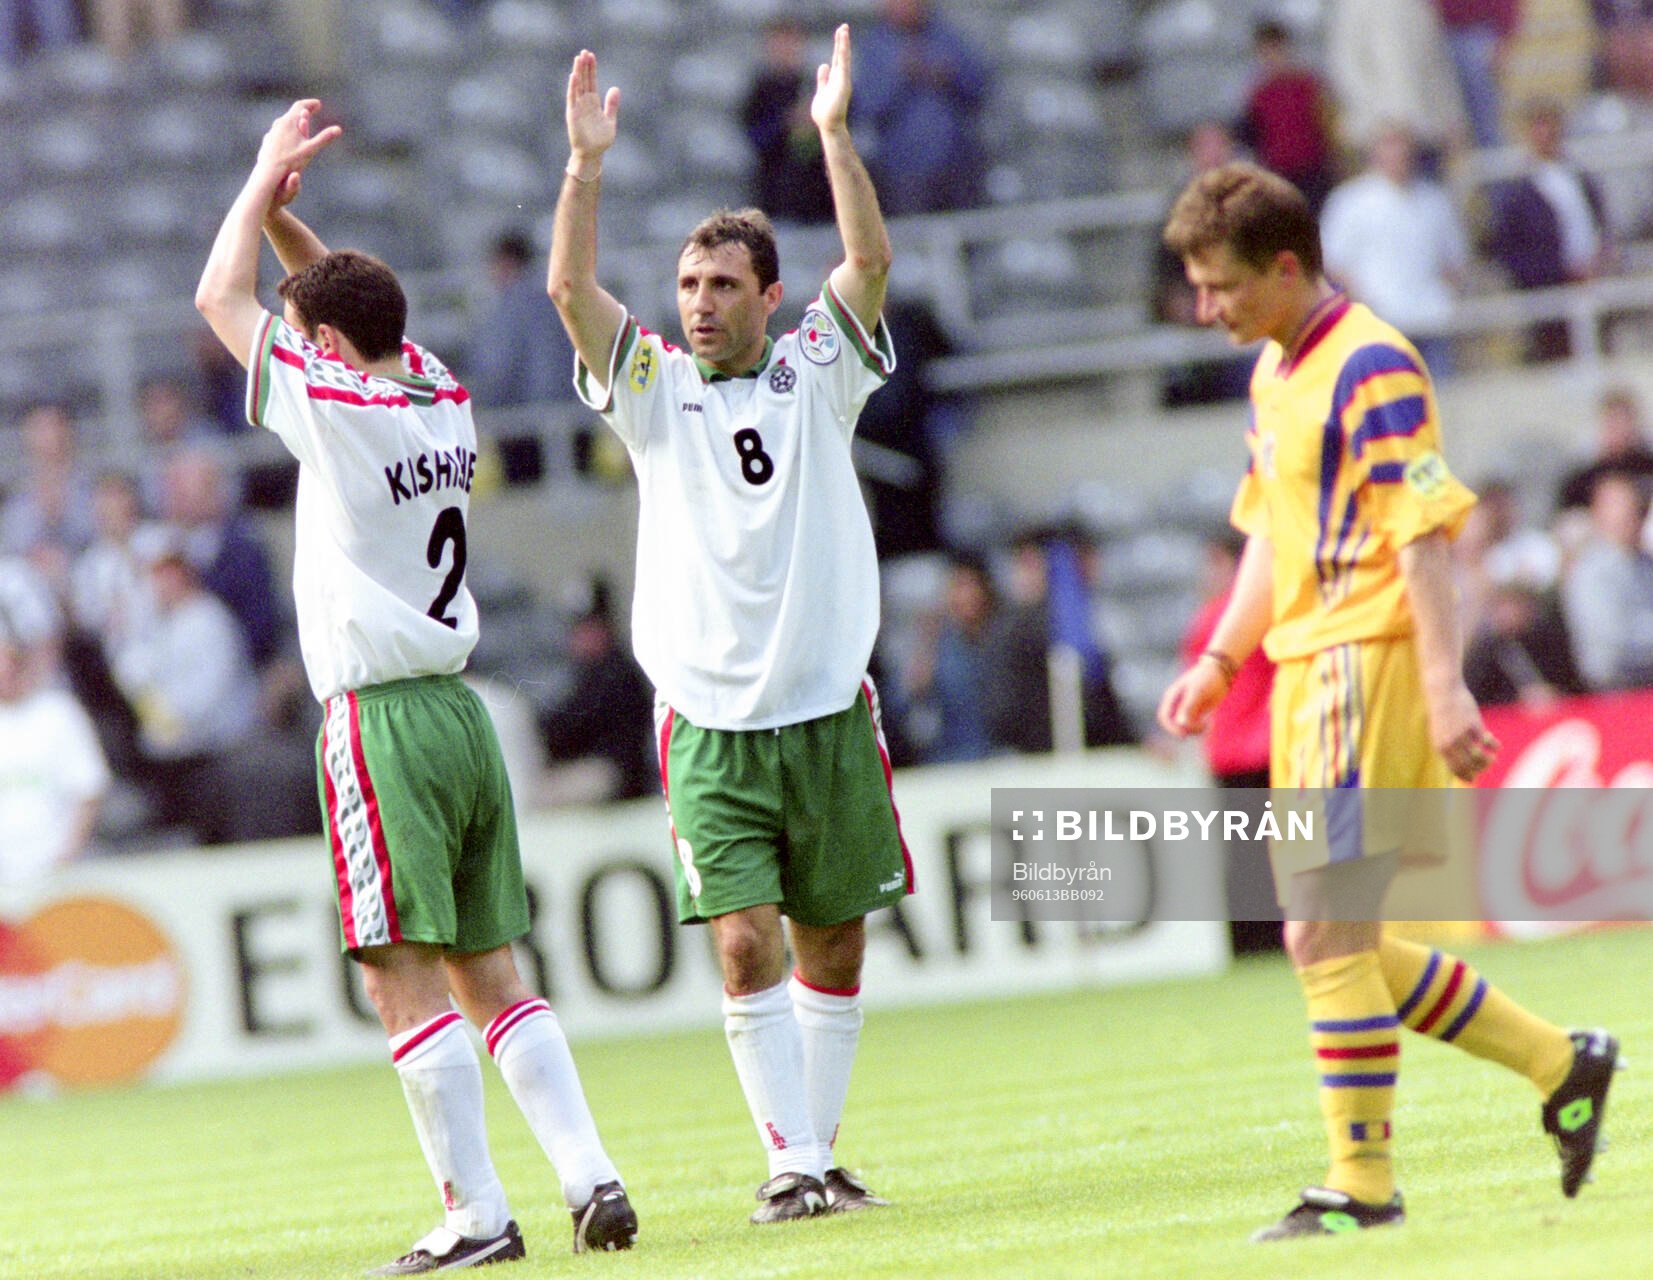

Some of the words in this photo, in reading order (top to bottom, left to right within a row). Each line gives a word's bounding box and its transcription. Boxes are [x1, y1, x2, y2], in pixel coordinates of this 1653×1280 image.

[733, 427, 774, 486] 8
[426, 506, 467, 631] 2
[677, 838, 702, 897] 8
